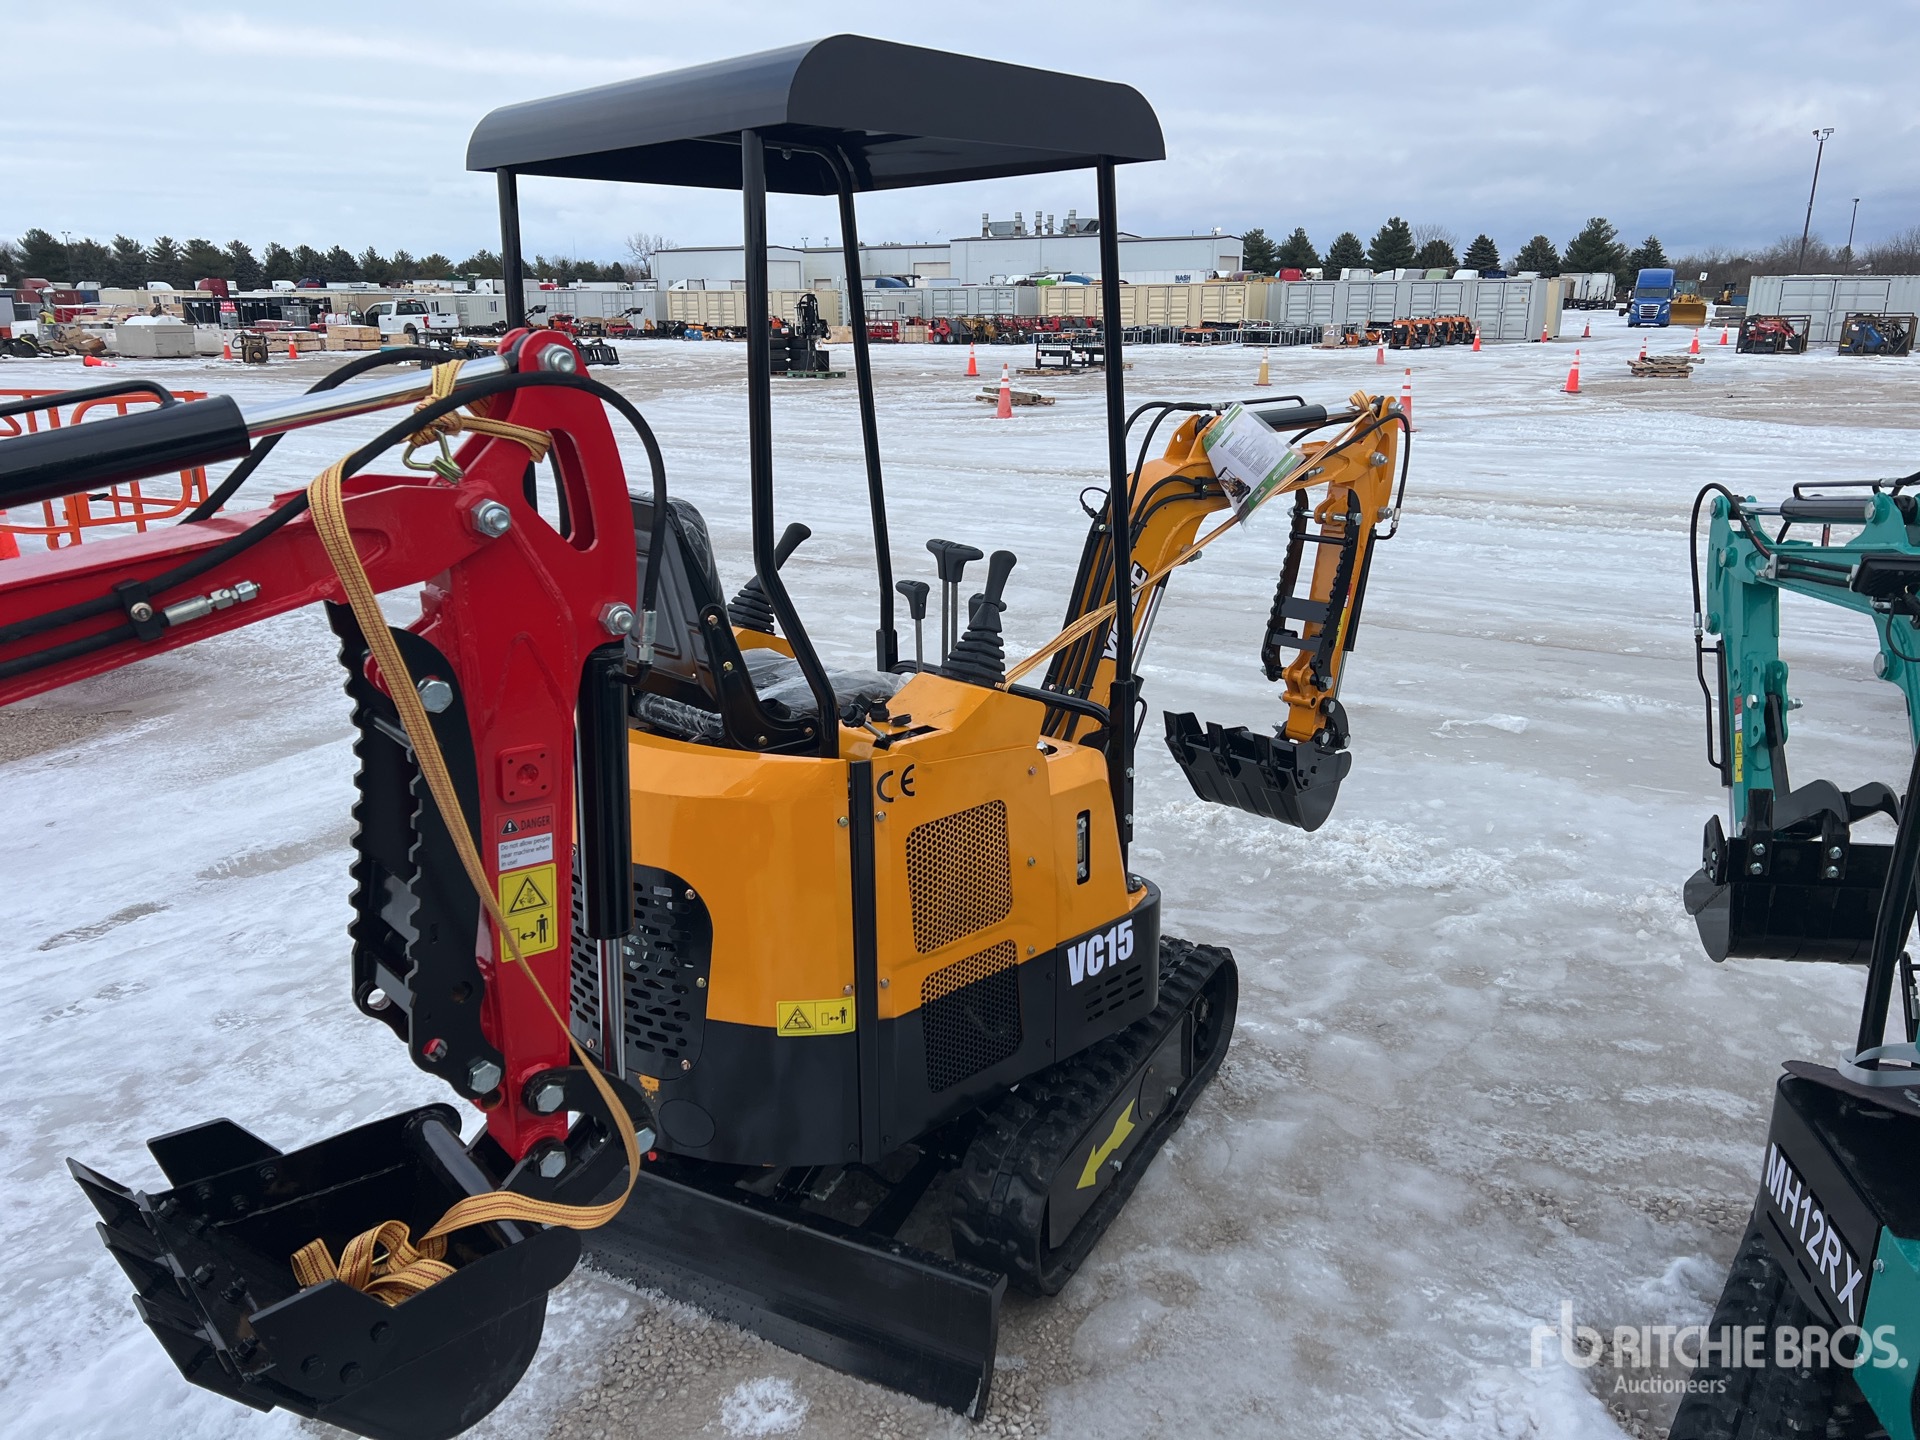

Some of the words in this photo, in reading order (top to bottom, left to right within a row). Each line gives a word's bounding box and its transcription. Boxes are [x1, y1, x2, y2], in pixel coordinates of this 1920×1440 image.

[877, 763, 915, 803] CE
[521, 815, 550, 830] DANGER
[513, 848, 534, 856] machine
[533, 836, 551, 845] people
[1067, 919, 1134, 986] VC15
[1765, 1142, 1863, 1323] MH12RX
